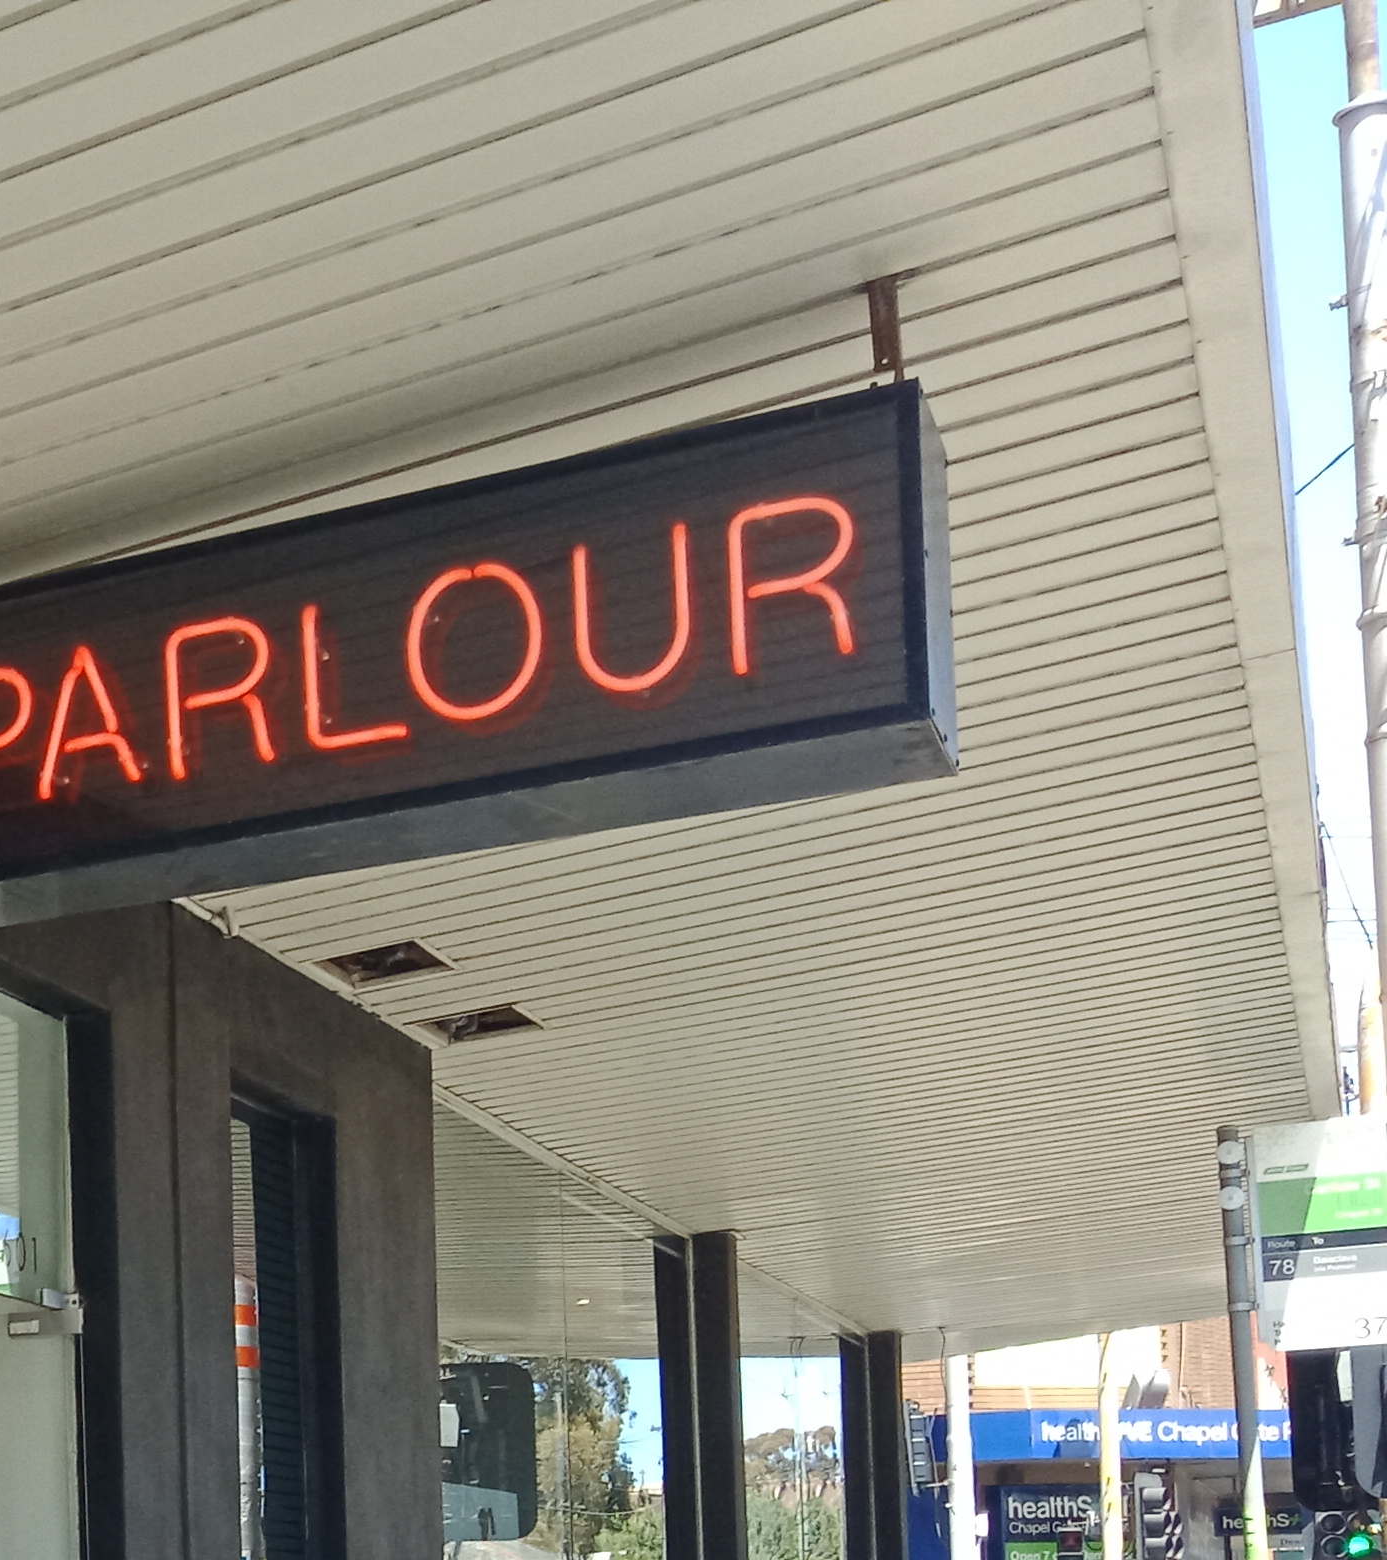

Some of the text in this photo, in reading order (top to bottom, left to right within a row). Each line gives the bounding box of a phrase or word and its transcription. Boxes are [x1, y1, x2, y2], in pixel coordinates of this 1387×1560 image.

[1311, 1236, 1325, 1245] To
[1268, 1258, 1296, 1276] 78
[1157, 1421, 1228, 1447] Chapel
[1008, 1521, 1051, 1537] Chapel
